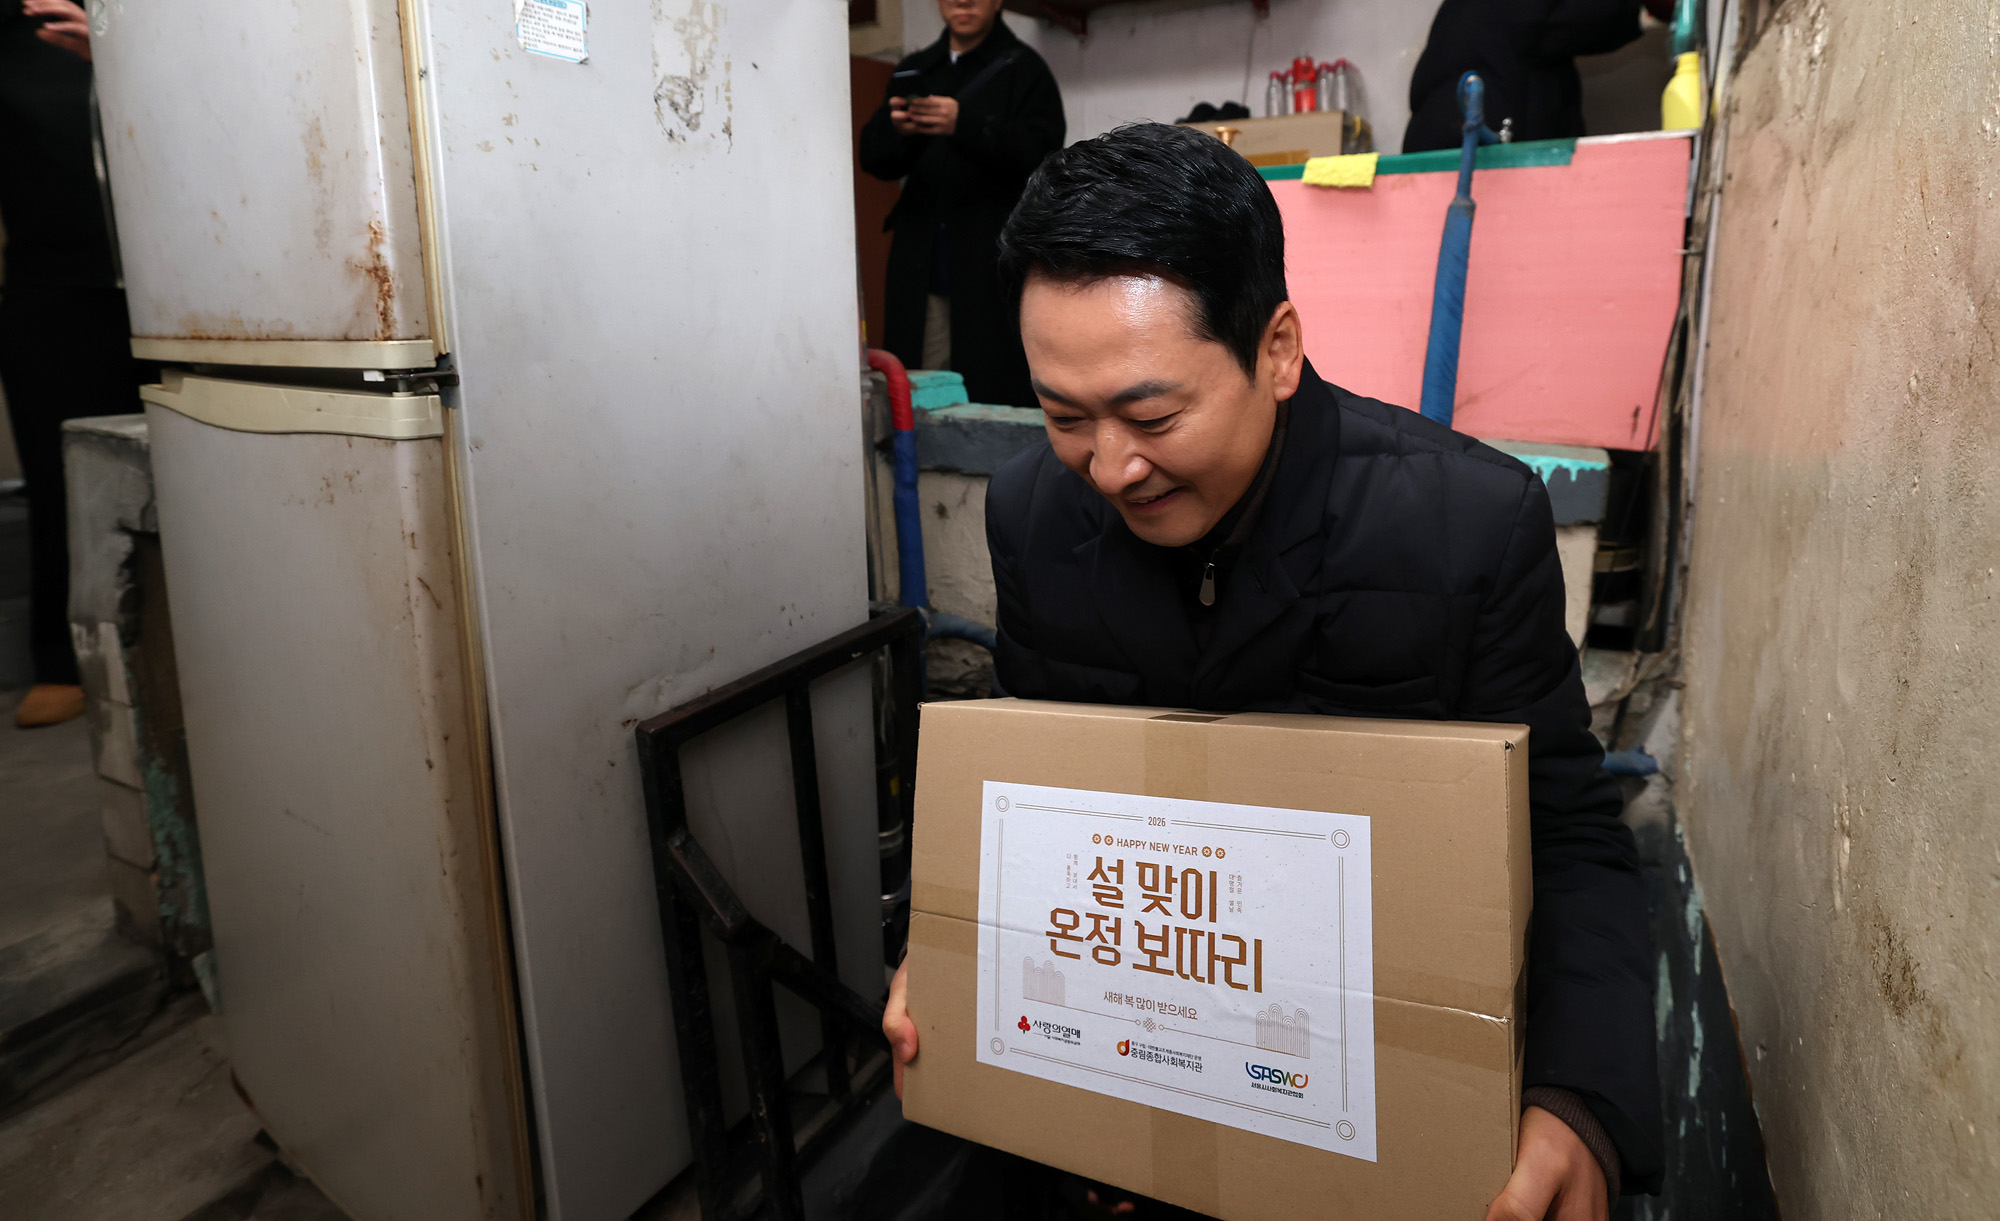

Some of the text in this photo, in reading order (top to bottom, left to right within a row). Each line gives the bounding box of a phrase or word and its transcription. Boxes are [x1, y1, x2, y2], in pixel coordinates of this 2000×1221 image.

[1148, 816, 1166, 827] 2026
[1116, 838, 1198, 856] HAPPY NEW YEAR
[1087, 856, 1217, 923] 설 맞이
[1045, 907, 1263, 993] 온정 보따리
[1104, 991, 1198, 1020] 새해 복 많이 받으세요
[1032, 1020, 1081, 1039] 사랑의열매
[1131, 1047, 1203, 1073] 중림종합사회복지관
